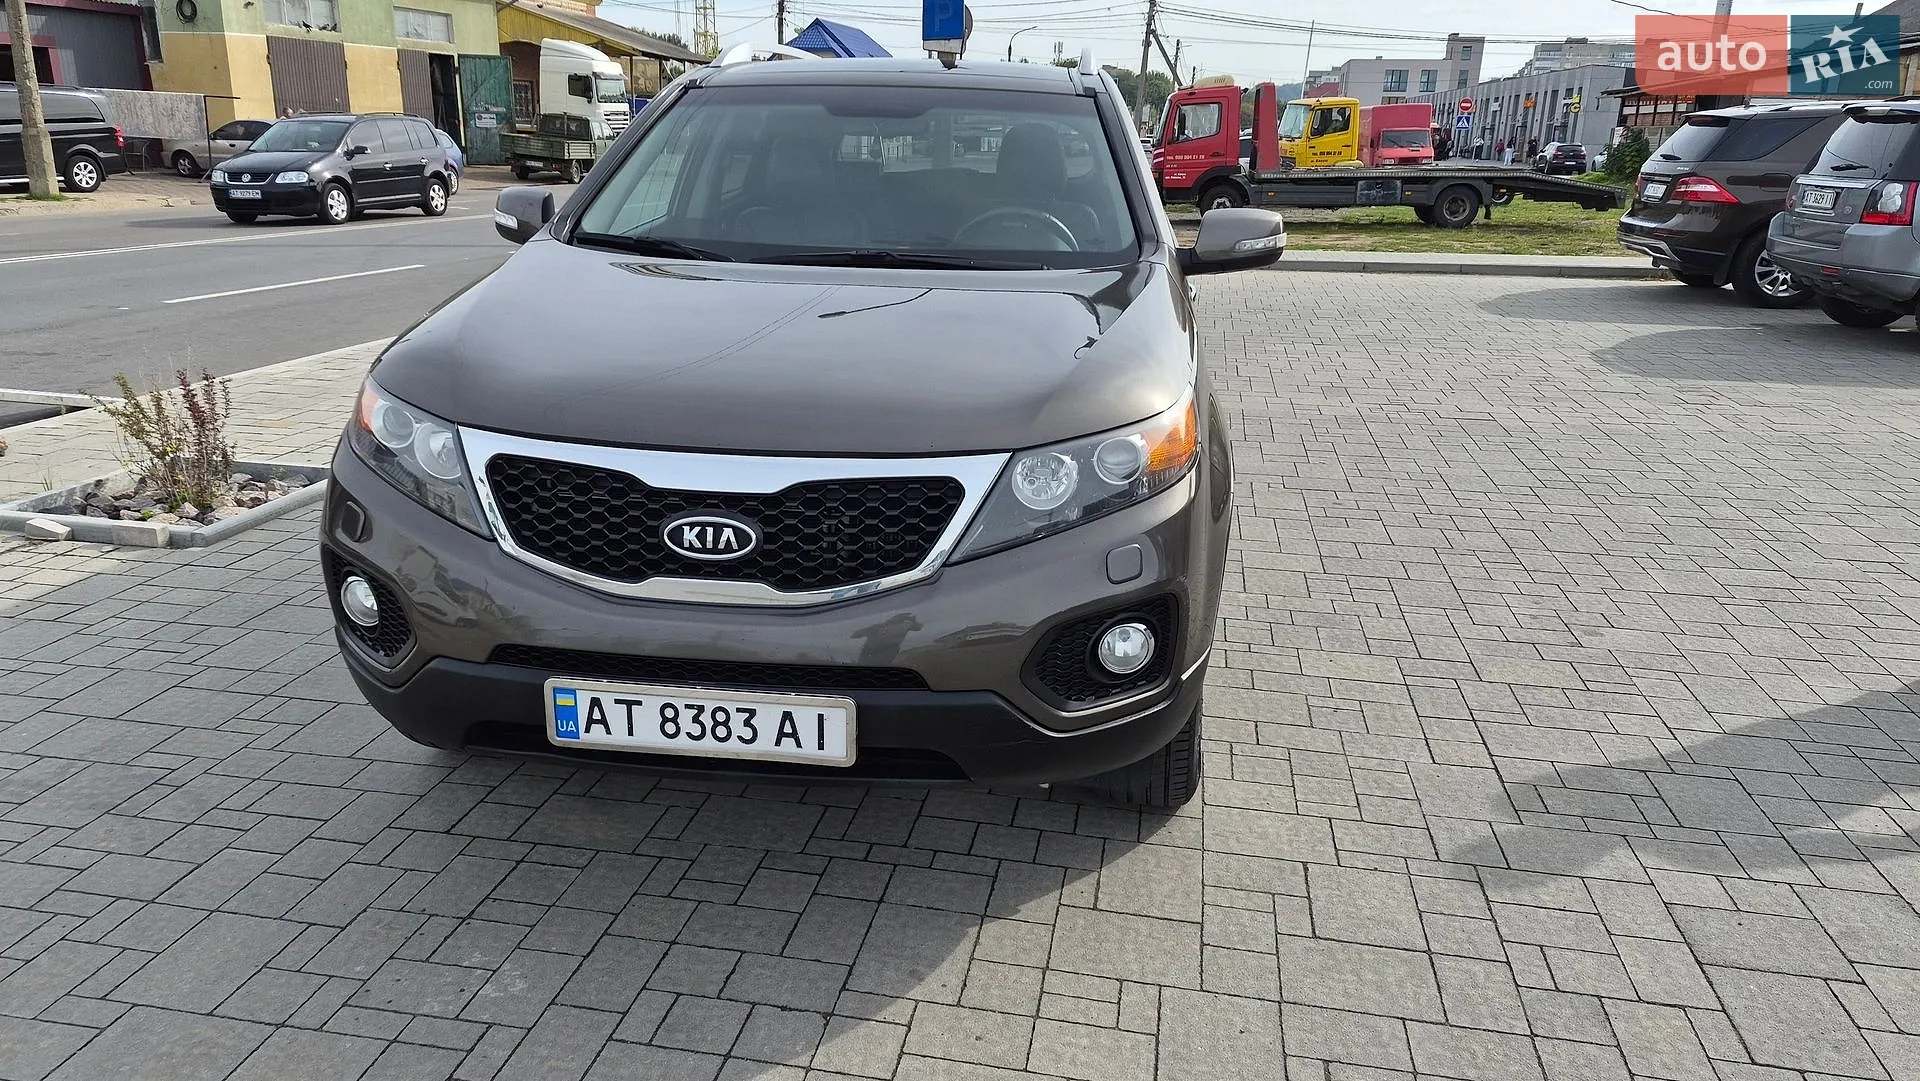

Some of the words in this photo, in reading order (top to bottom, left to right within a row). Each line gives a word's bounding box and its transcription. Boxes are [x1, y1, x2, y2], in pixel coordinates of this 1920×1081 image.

[682, 525, 739, 549] KIA
[557, 720, 577, 733] UA
[584, 696, 643, 737] AT
[659, 702, 759, 745] 8383
[774, 710, 826, 751] AI
